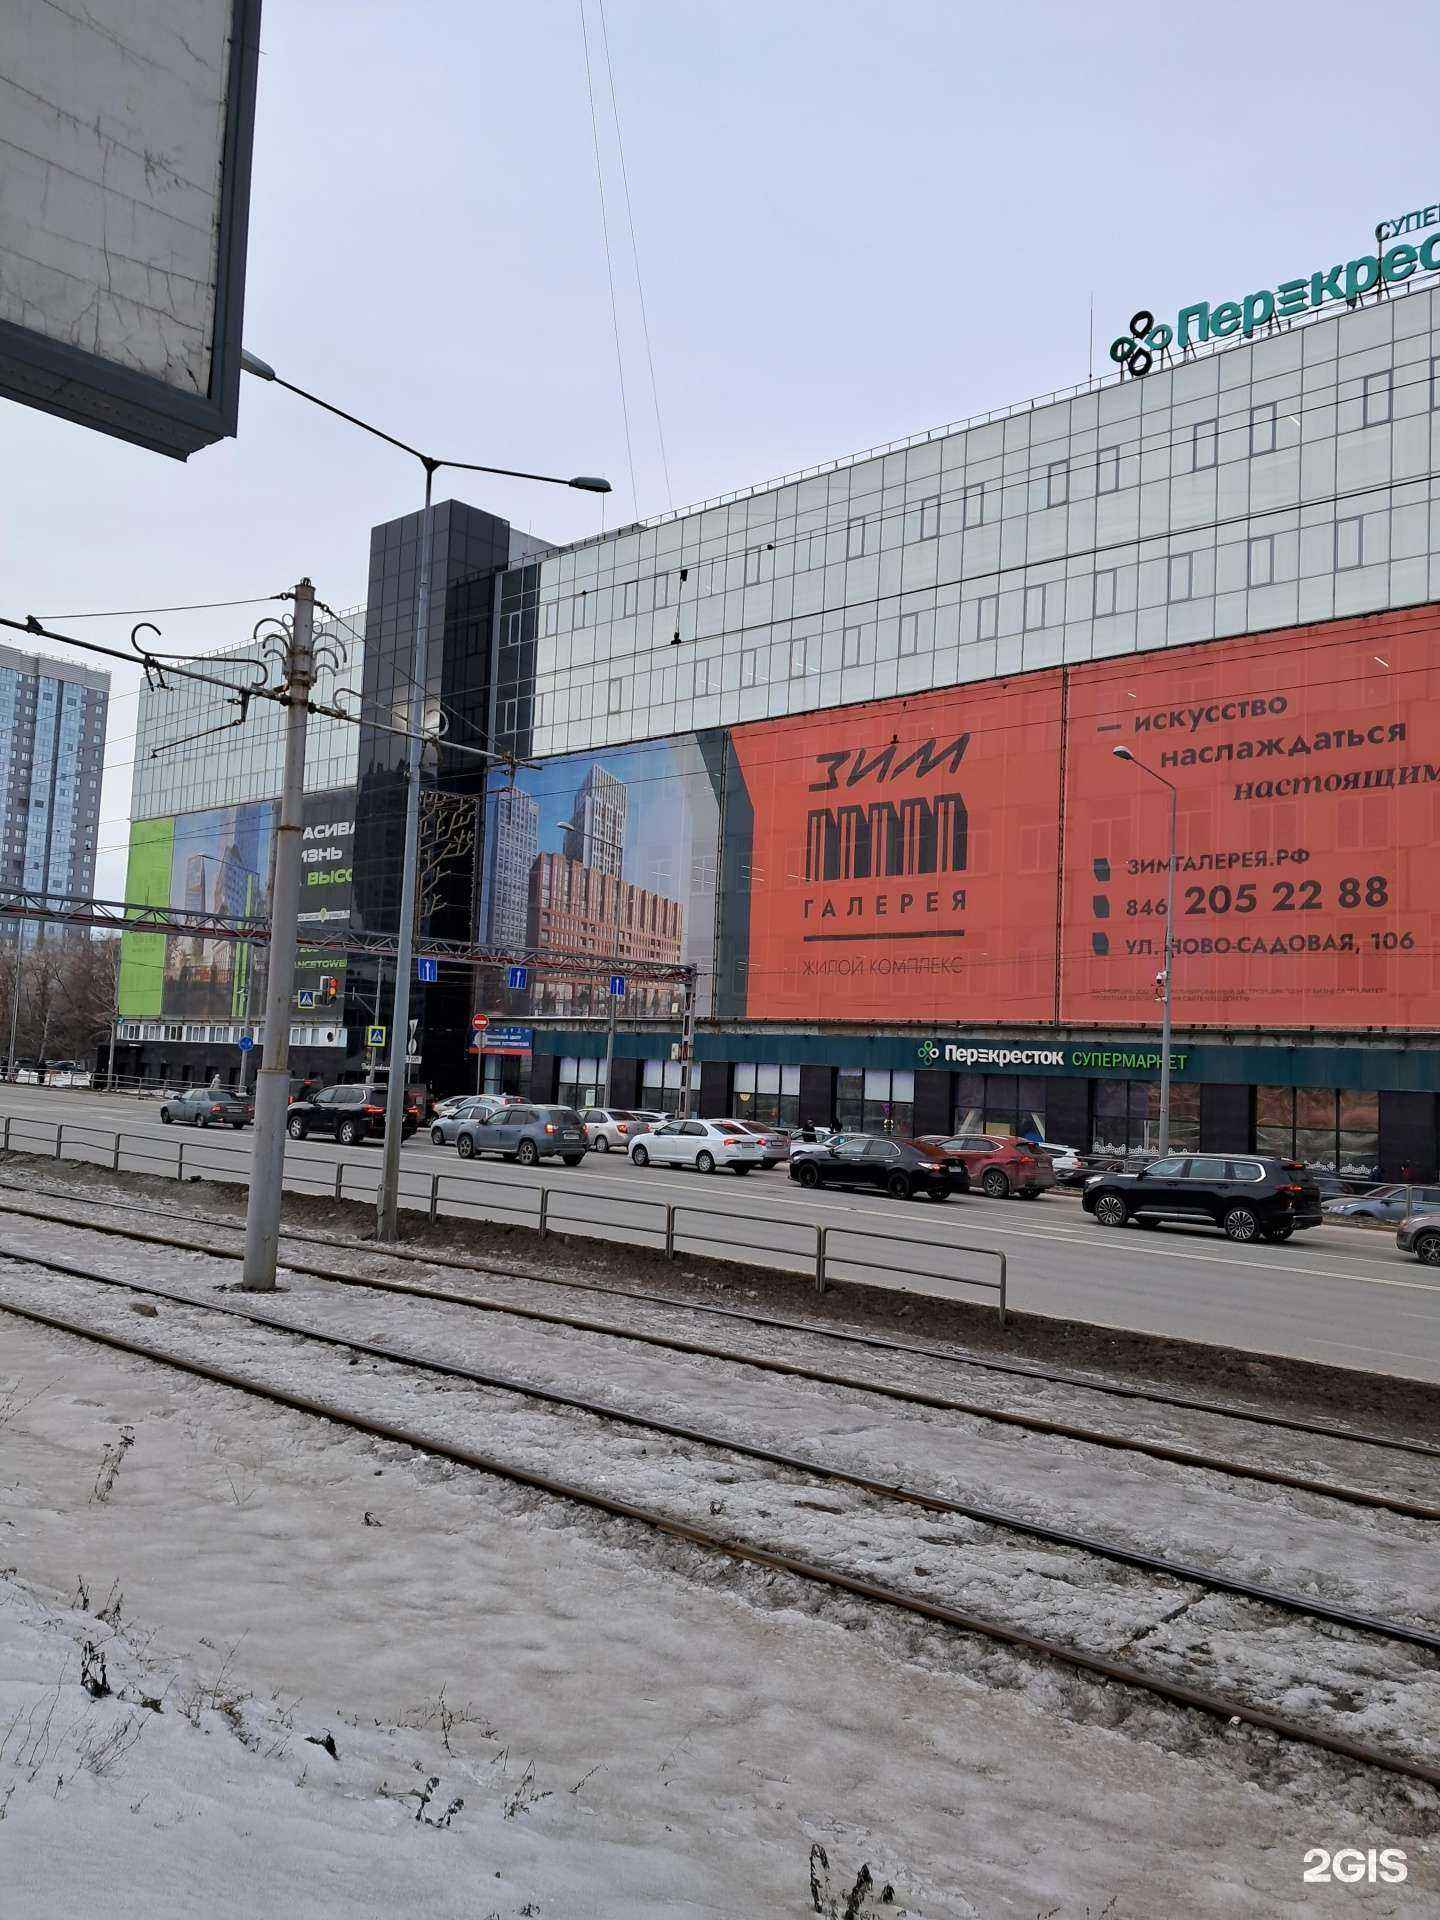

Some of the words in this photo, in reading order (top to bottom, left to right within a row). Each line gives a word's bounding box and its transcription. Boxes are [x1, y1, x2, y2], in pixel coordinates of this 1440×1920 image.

[1375, 203, 1440, 242] СУПЕ
[1134, 697, 1287, 733] искусство
[809, 732, 970, 792] ЗИМ
[1161, 722, 1406, 768] наслаждаться
[804, 889, 966, 918] ГАЛЕРЕЯ
[1126, 898, 1168, 916] 846
[1184, 884, 1257, 915] 205
[1272, 880, 1322, 911] 22
[1338, 876, 1389, 908] 88
[1371, 932, 1415, 949] 106
[803, 958, 864, 976] ЖИЛОЙ
[869, 957, 963, 975] КОМПЛЕКС
